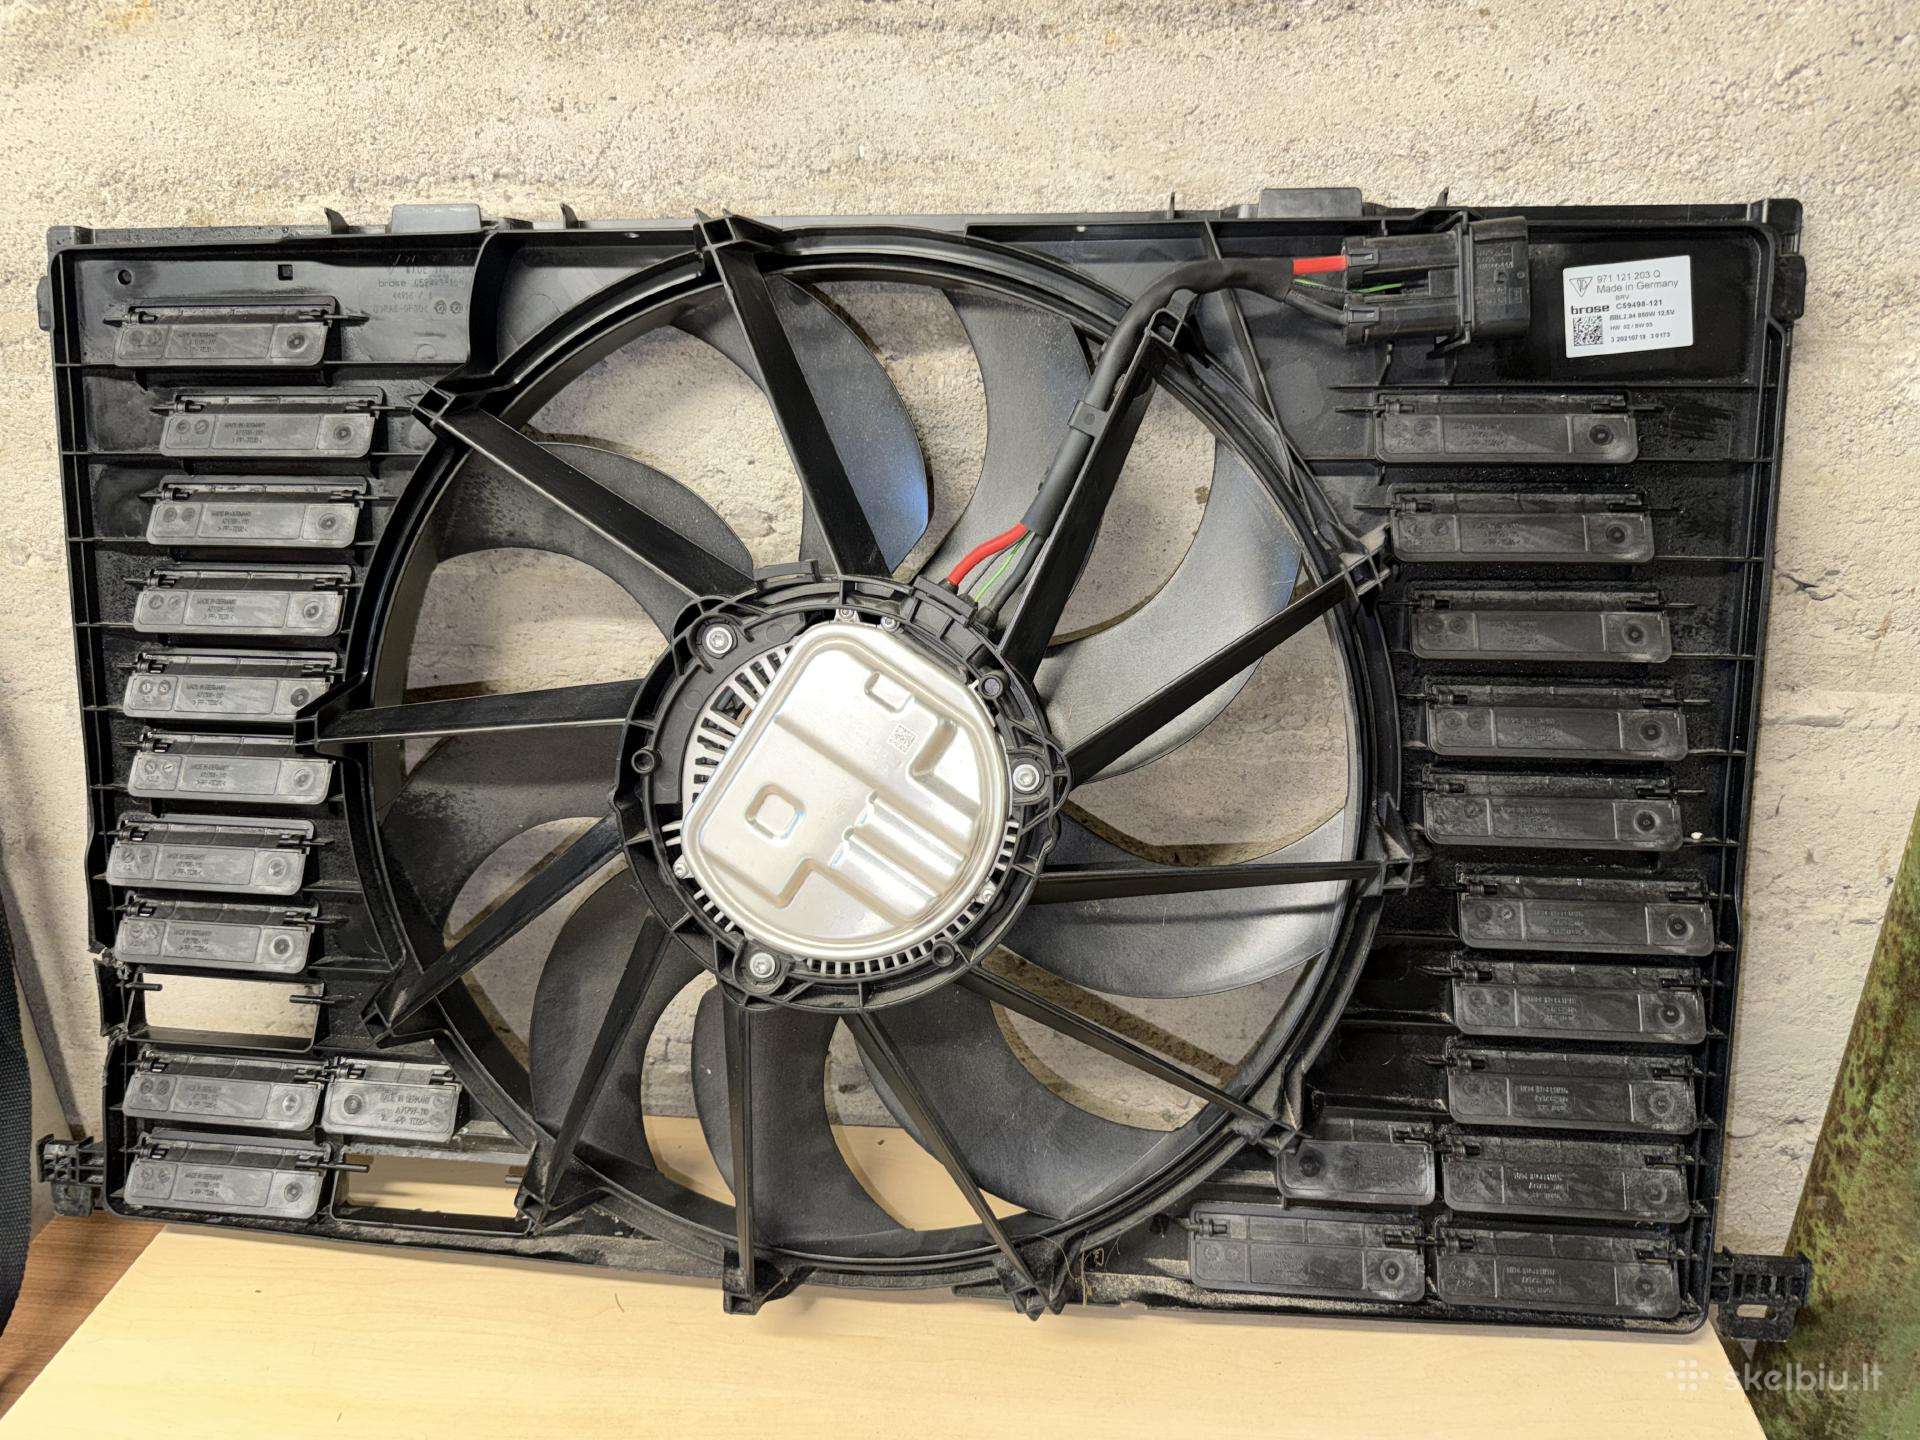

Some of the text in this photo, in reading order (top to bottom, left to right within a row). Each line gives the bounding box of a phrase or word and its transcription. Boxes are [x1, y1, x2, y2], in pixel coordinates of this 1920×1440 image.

[1597, 270, 1661, 283] 971 121 203 Q
[1596, 279, 1679, 294] Made in Germany
[1570, 304, 1610, 315] brose
